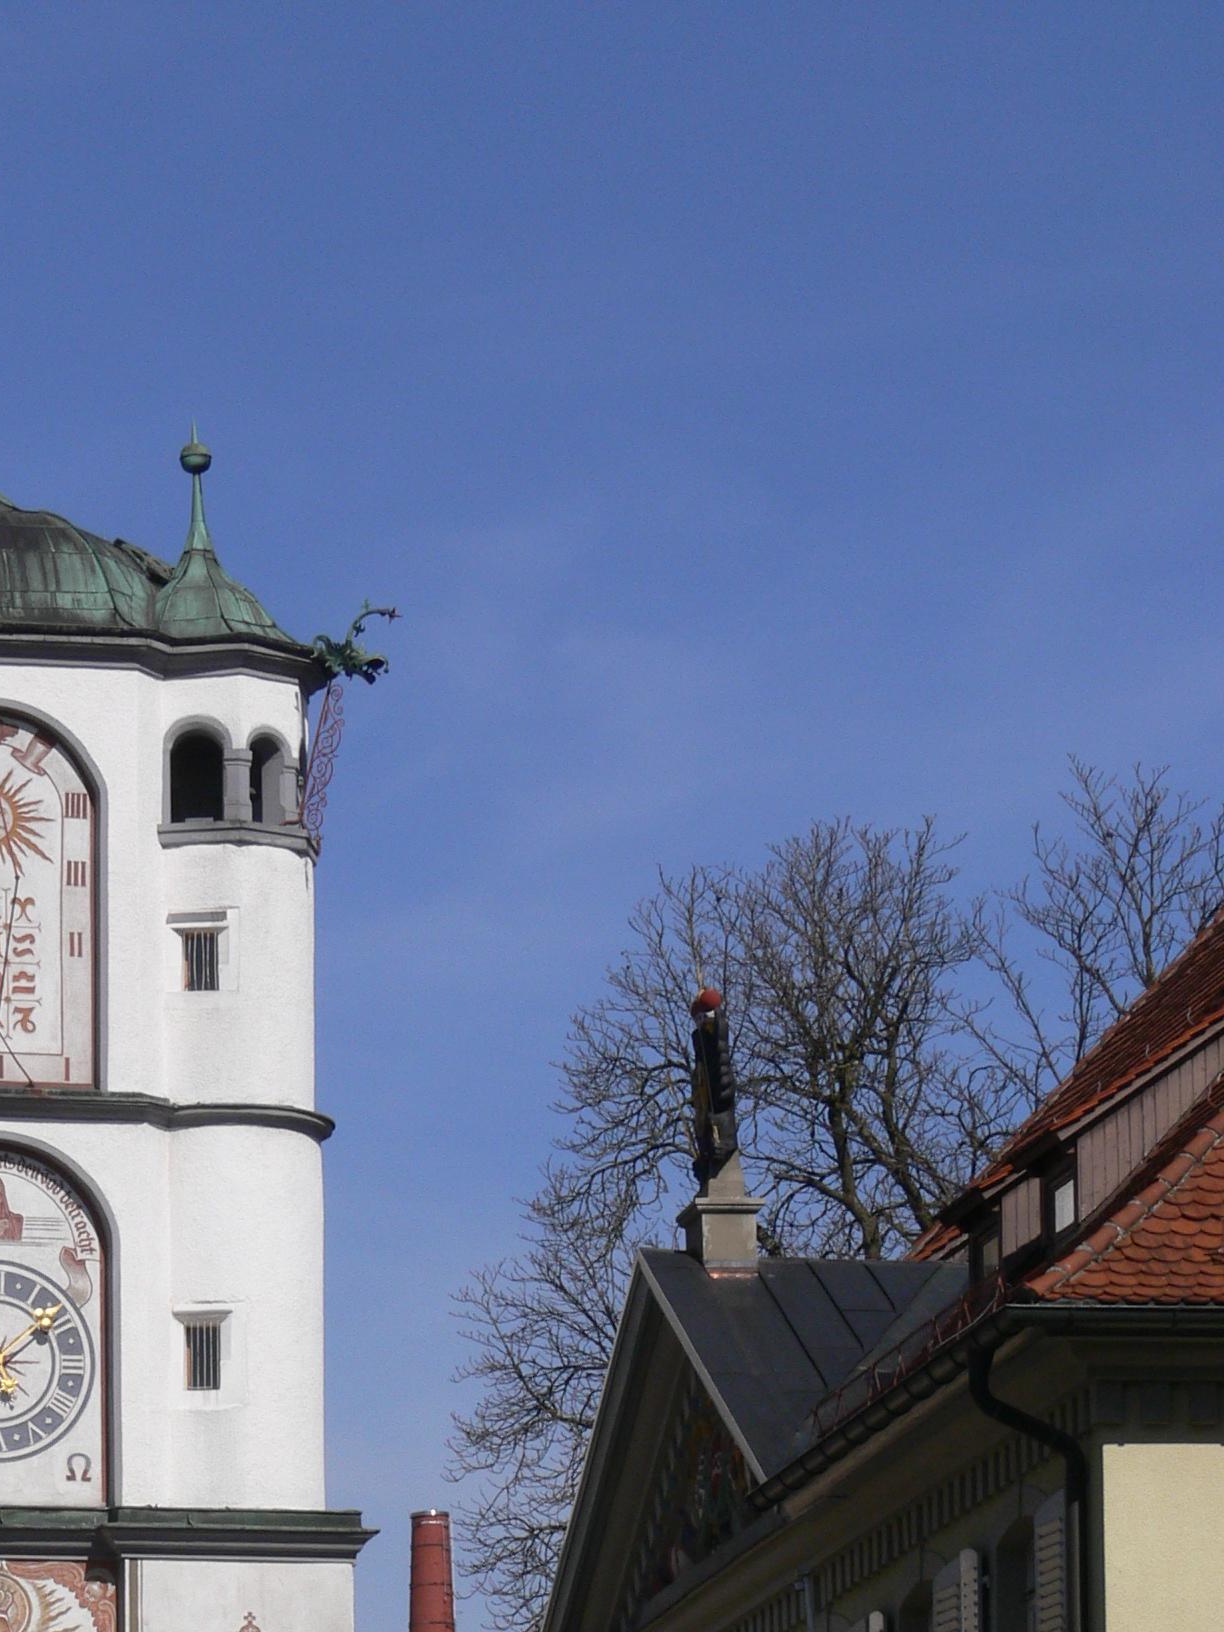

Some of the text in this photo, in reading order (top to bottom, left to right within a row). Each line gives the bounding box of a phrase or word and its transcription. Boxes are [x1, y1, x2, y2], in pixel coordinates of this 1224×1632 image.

[64, 792, 88, 819] IIII
[66, 860, 87, 887] III
[69, 931, 83, 958] II
[63, 1057, 70, 1081] I
[61, 1354, 84, 1374] III
[48, 1392, 74, 1419] IIII
[28, 1421, 47, 1445] V
